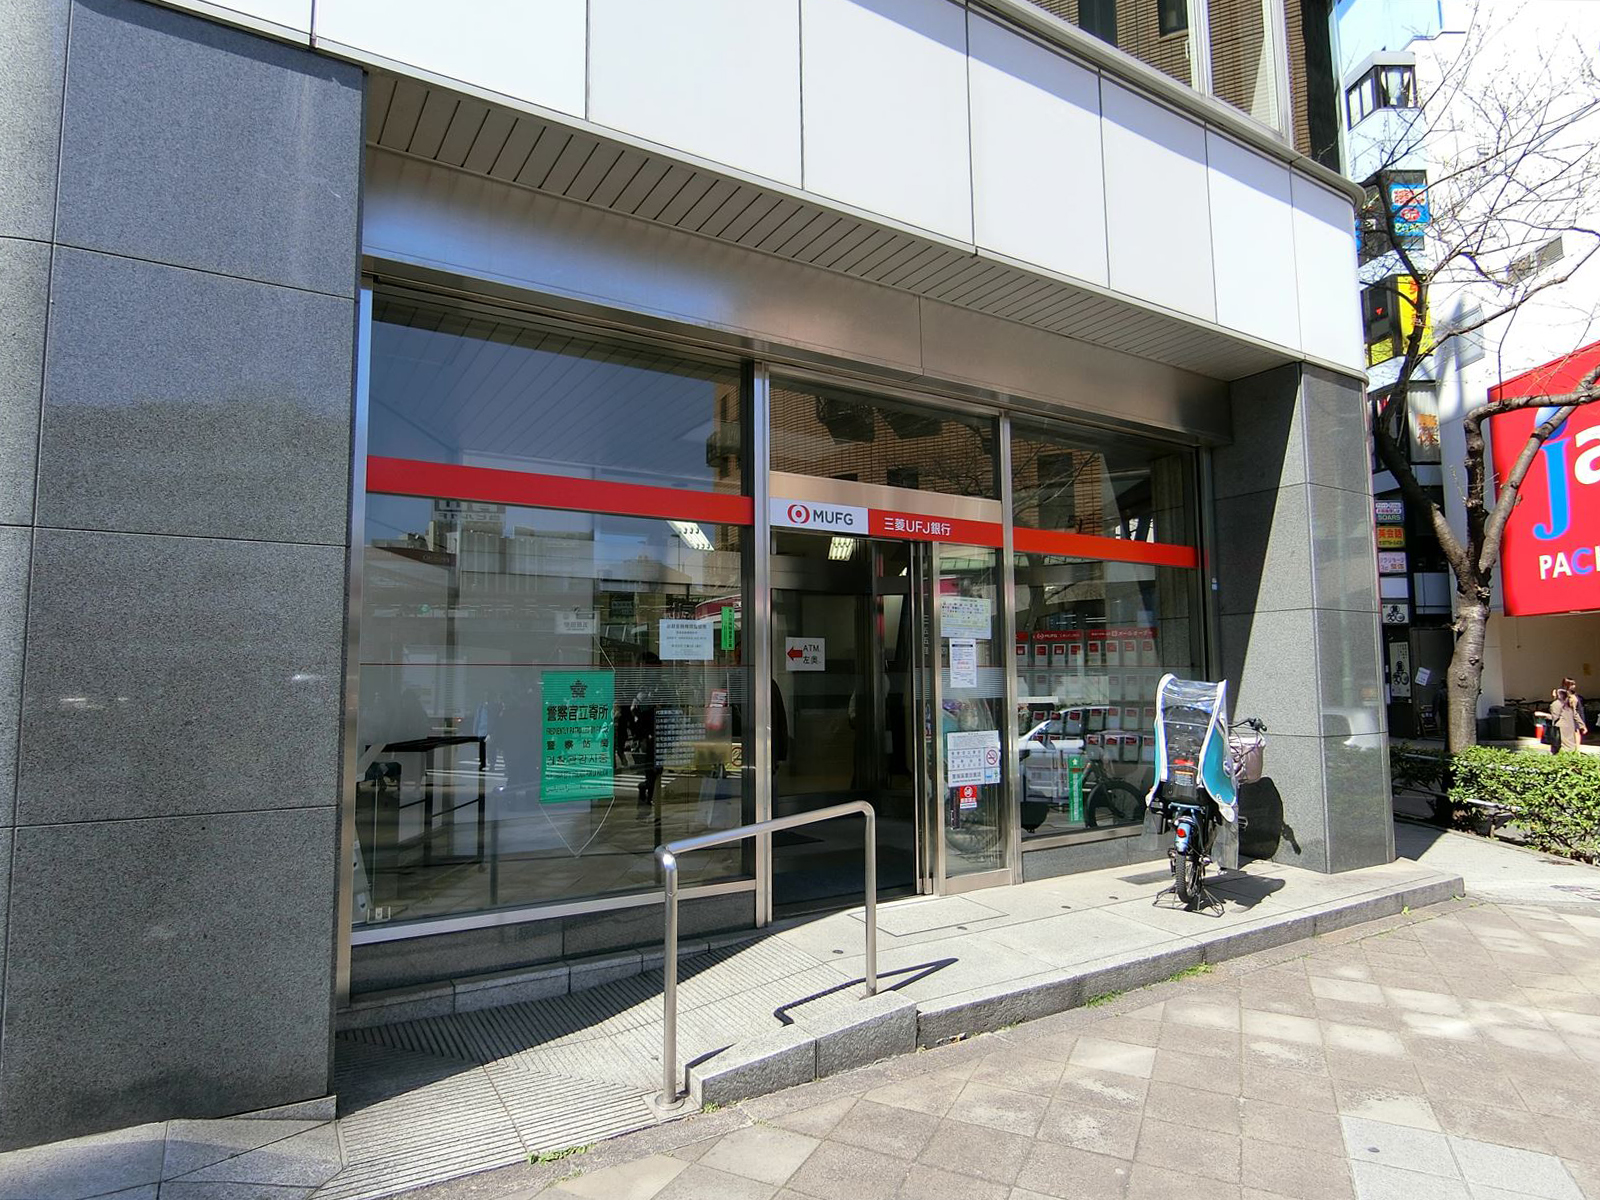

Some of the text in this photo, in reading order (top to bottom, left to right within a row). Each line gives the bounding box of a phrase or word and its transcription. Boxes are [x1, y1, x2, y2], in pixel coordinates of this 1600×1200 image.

[812, 509, 853, 526] MUFG
[883, 516, 951, 537] 三菱UFJ銀行
[1378, 528, 1402, 539] 英会話
[1539, 546, 1600, 580] PAC
[803, 644, 820, 652] ATM
[546, 702, 608, 722] 警察官立寄所
